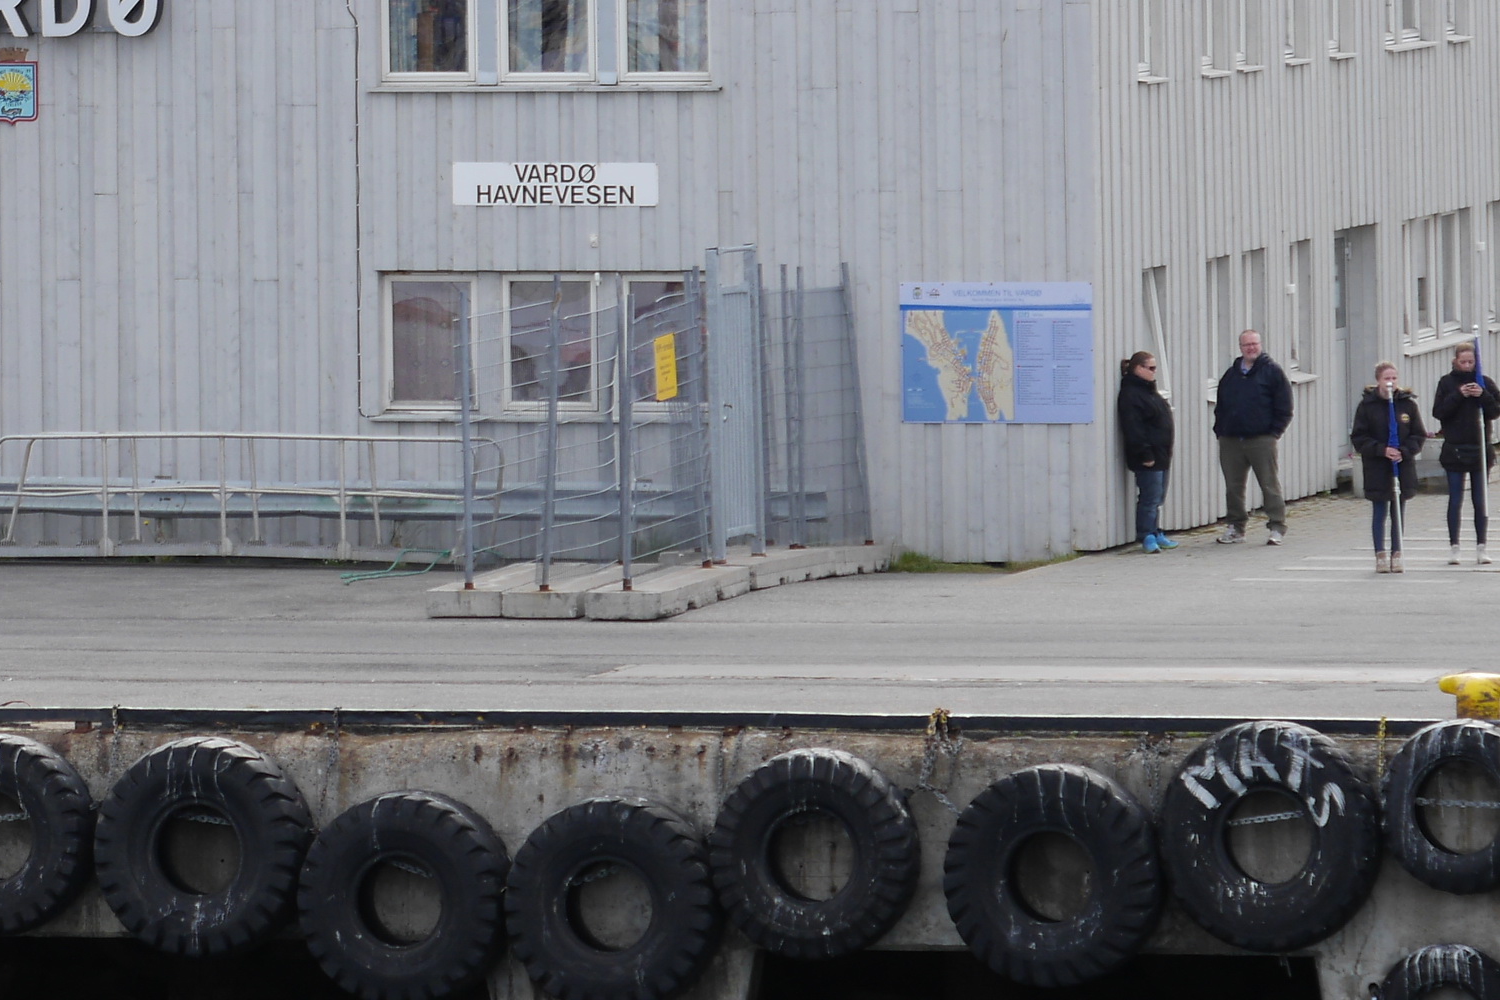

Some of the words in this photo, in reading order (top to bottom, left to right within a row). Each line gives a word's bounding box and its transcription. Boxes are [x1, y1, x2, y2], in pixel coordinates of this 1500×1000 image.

[514, 163, 597, 183] VARDØ
[476, 184, 635, 204] HAVNEVESEN
[952, 289, 1000, 297] VELKOMMEN
[1003, 289, 1012, 297] TIL
